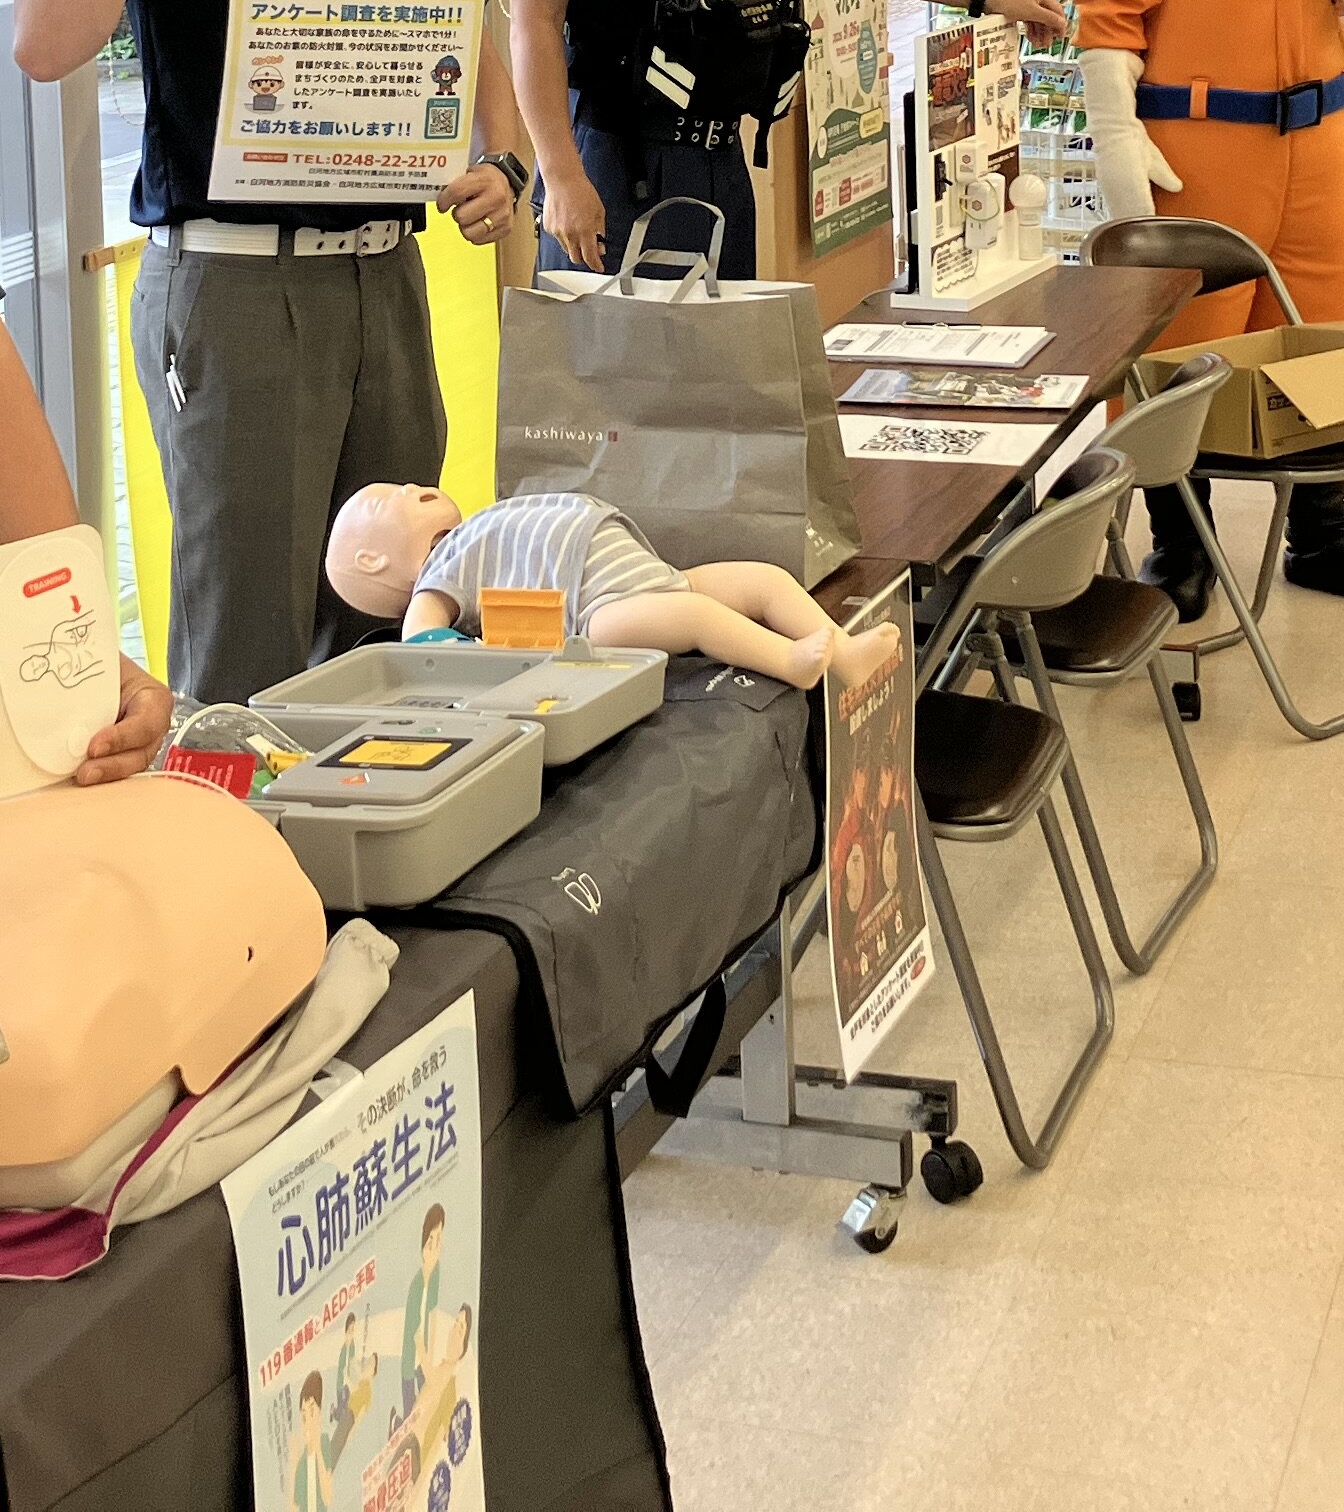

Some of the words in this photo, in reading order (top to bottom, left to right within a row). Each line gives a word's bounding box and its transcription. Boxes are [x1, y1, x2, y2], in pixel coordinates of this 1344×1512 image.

[251, 3, 463, 24] アンケート調査を実施中!!
[294, 73, 423, 84] まちづくりのため、全戸を対象と
[293, 87, 422, 98] したアンケート調査を実施いたし
[292, 100, 314, 110] ます。
[240, 119, 412, 137] ご協力をお願いします!!
[525, 426, 604, 445] kashiwaya
[27, 571, 68, 594] TRAINING
[277, 1081, 457, 1297] 心肺蘇生法
[260, 1257, 377, 1388] 119番通報とAEDの手配
